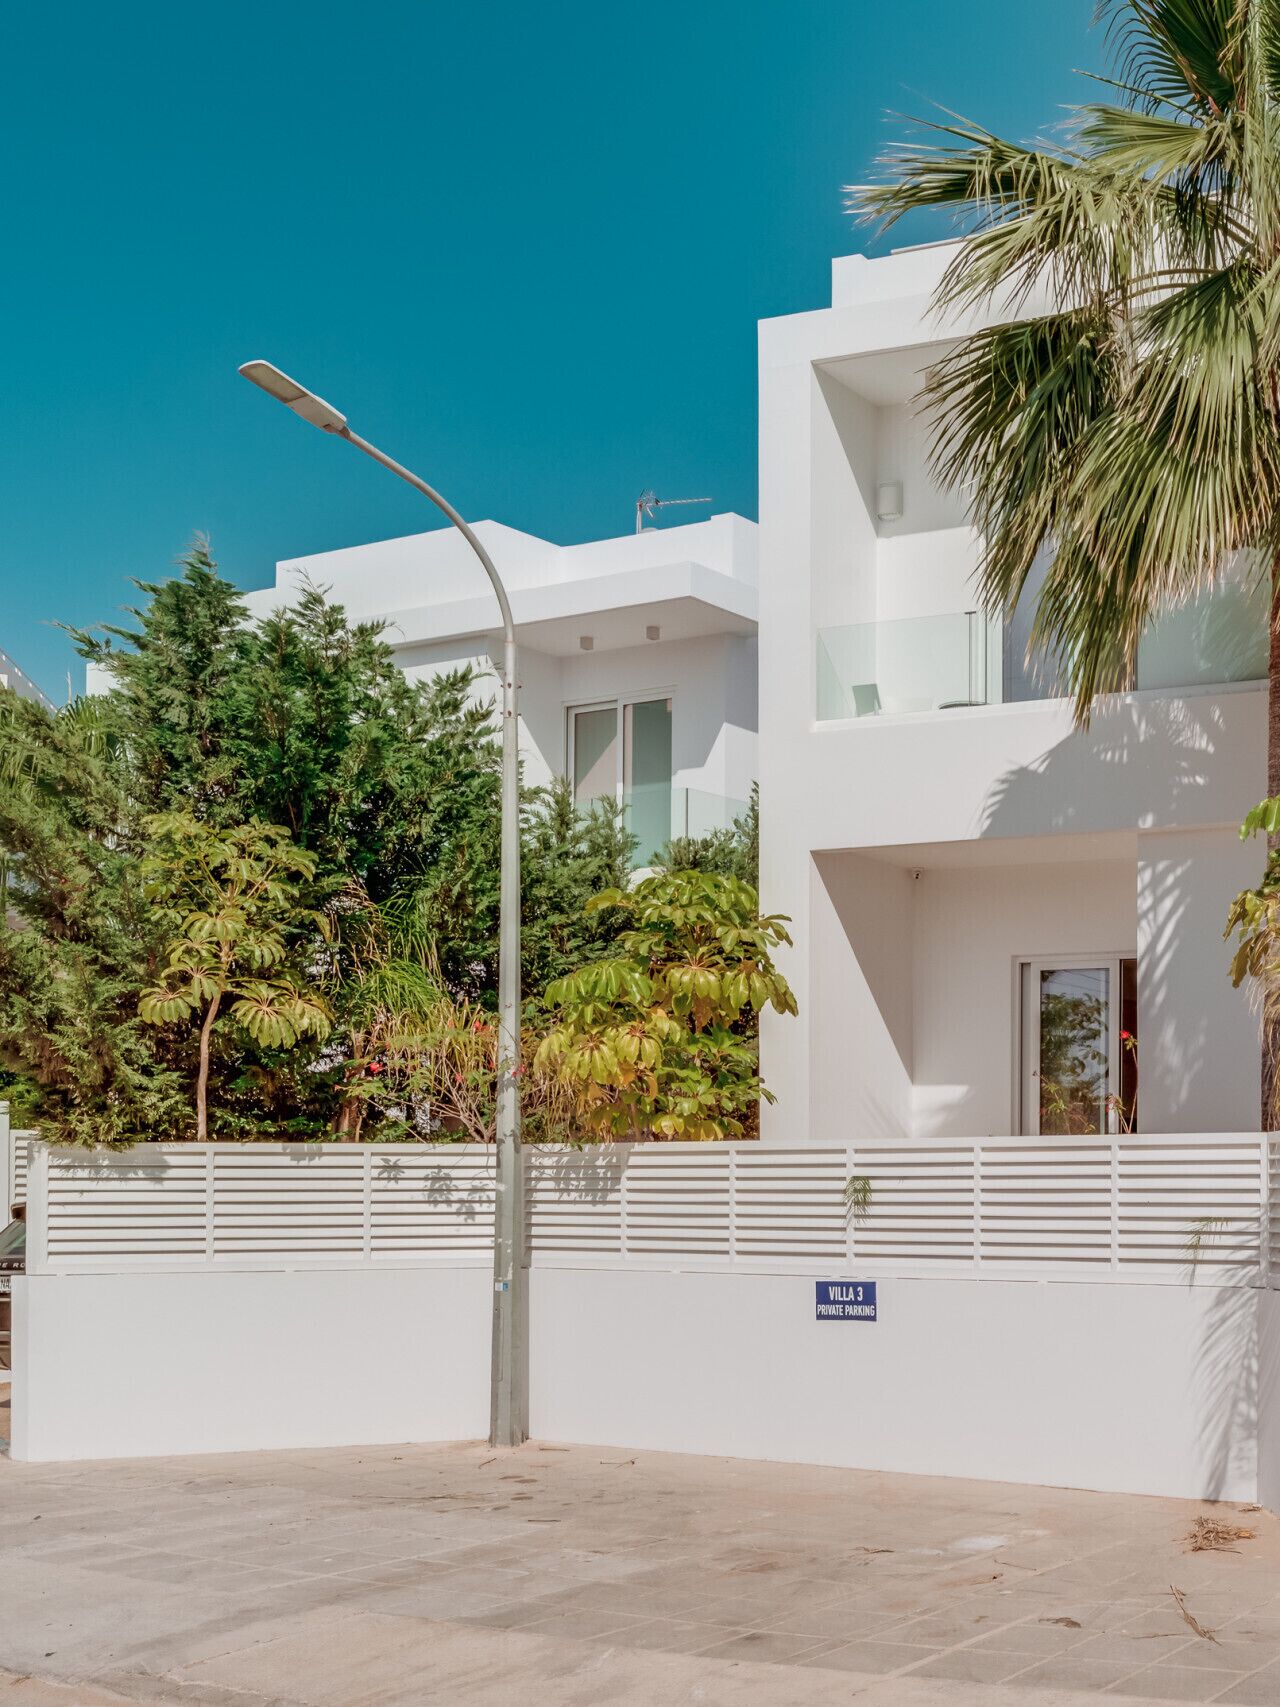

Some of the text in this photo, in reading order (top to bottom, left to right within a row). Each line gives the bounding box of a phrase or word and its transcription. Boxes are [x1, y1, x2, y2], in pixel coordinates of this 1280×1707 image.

[828, 1286, 863, 1302] VILLA 3
[817, 1304, 875, 1317] PRIVATE PARKING
